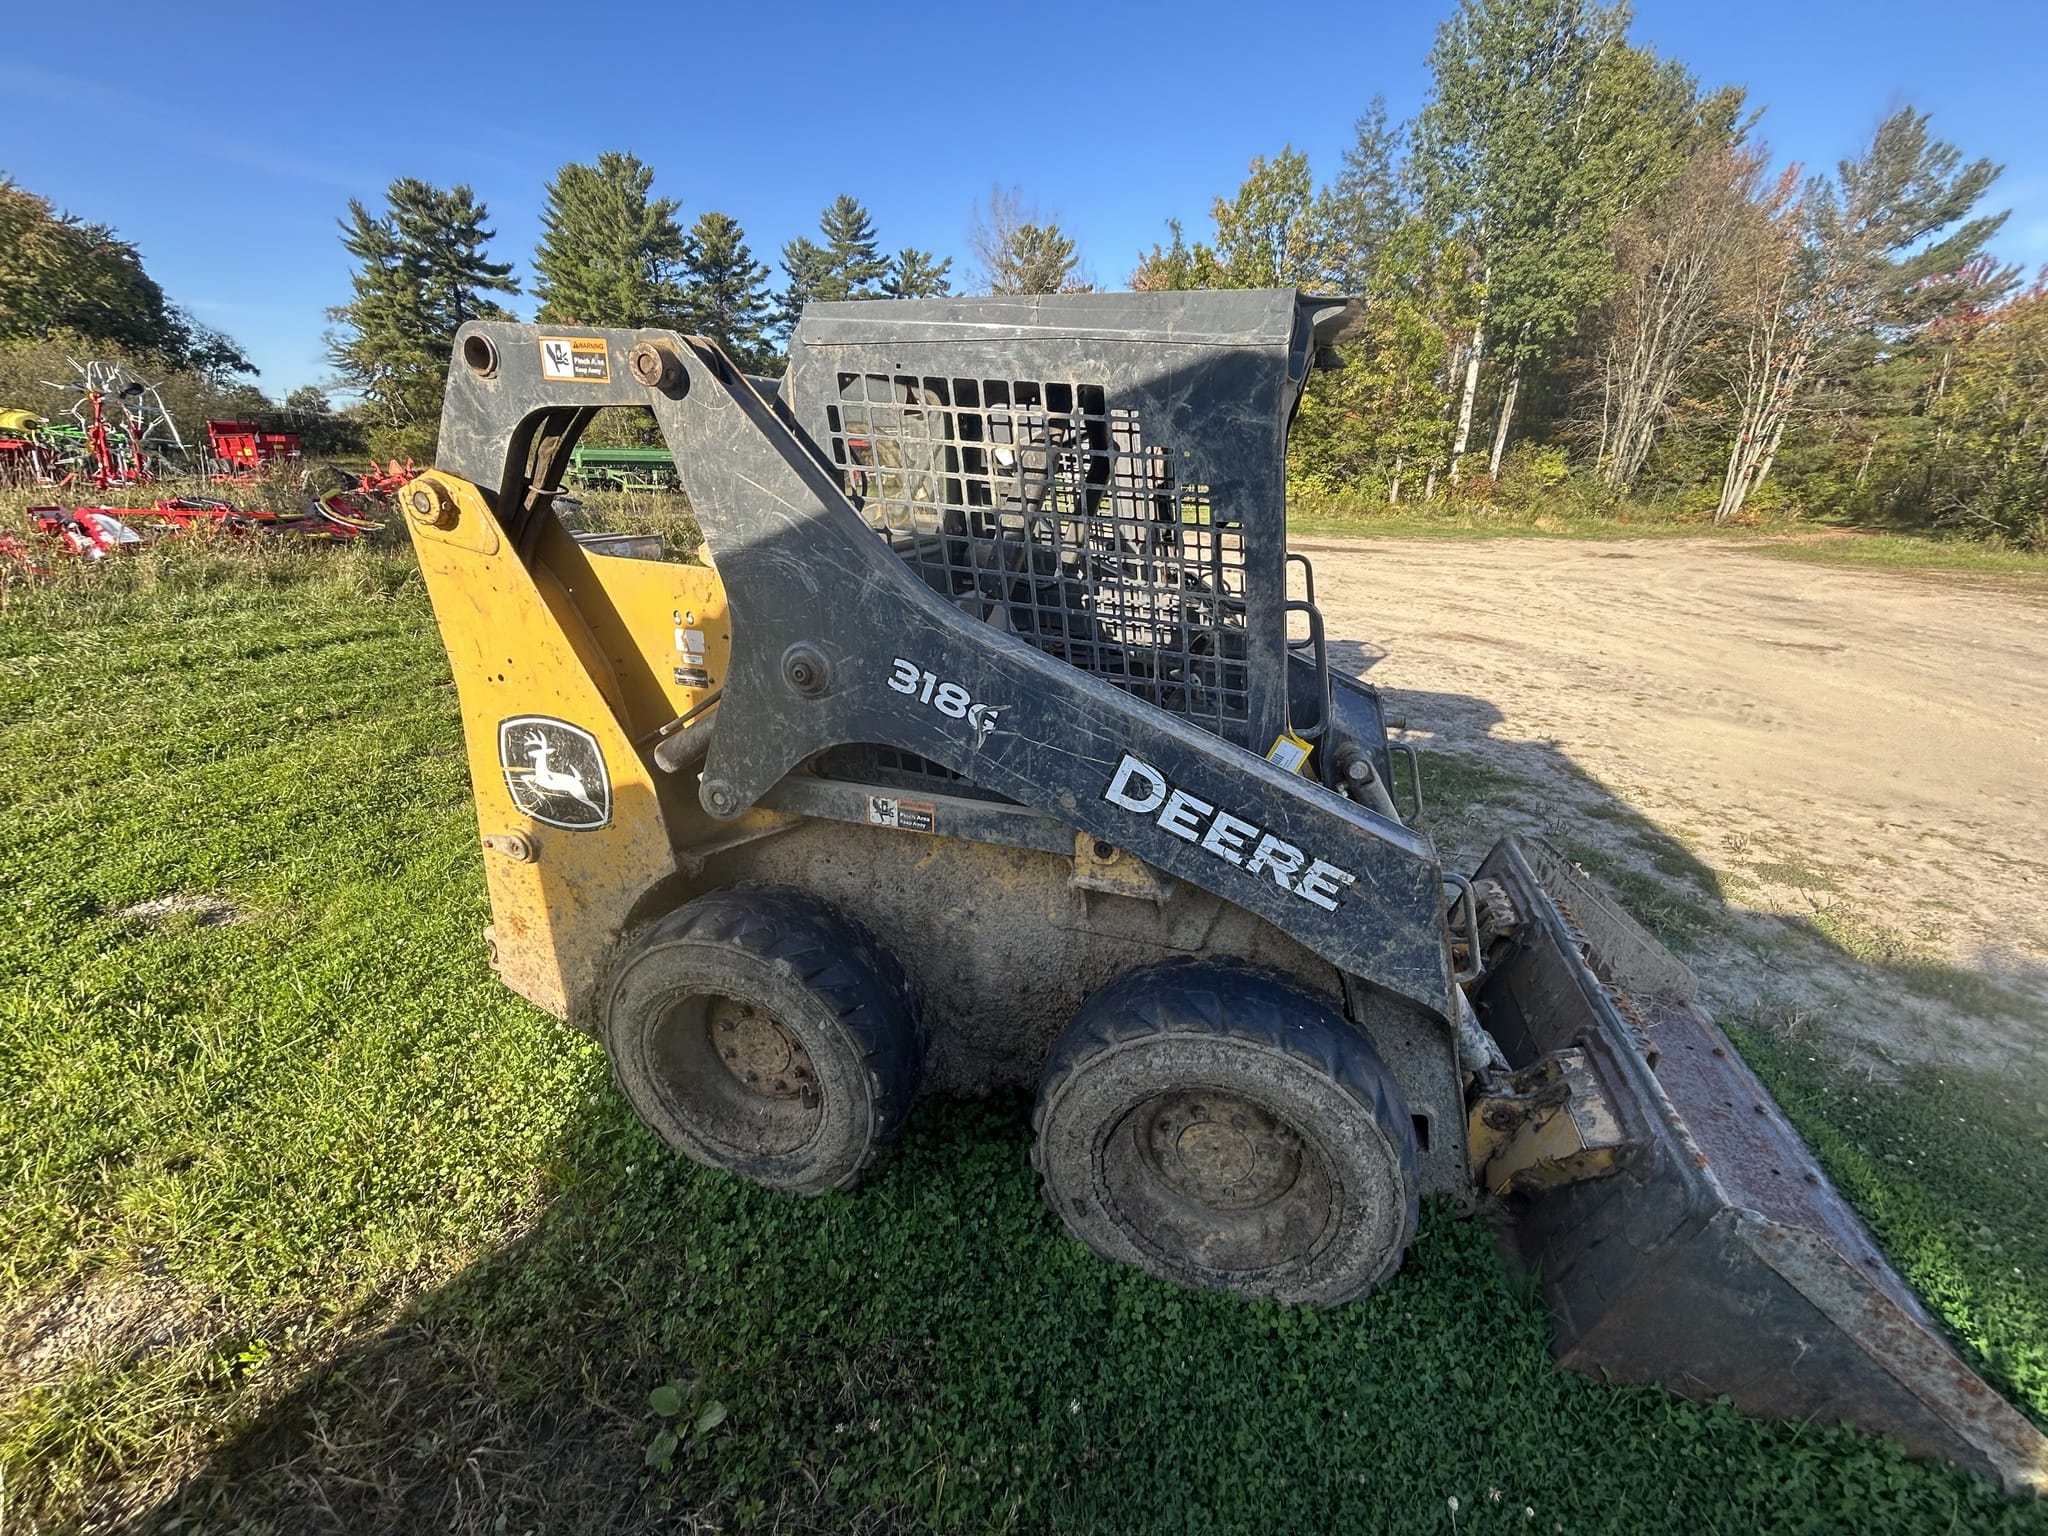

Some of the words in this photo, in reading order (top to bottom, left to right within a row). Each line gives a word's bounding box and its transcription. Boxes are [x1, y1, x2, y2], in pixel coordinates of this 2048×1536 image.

[578, 342, 604, 350] WARNING
[574, 356, 590, 365] Pinch
[575, 366, 588, 375] Keep
[588, 367, 602, 375] Away
[887, 658, 999, 735] 318G
[899, 812, 916, 821] Pinch
[1105, 754, 1356, 912] DEERE
